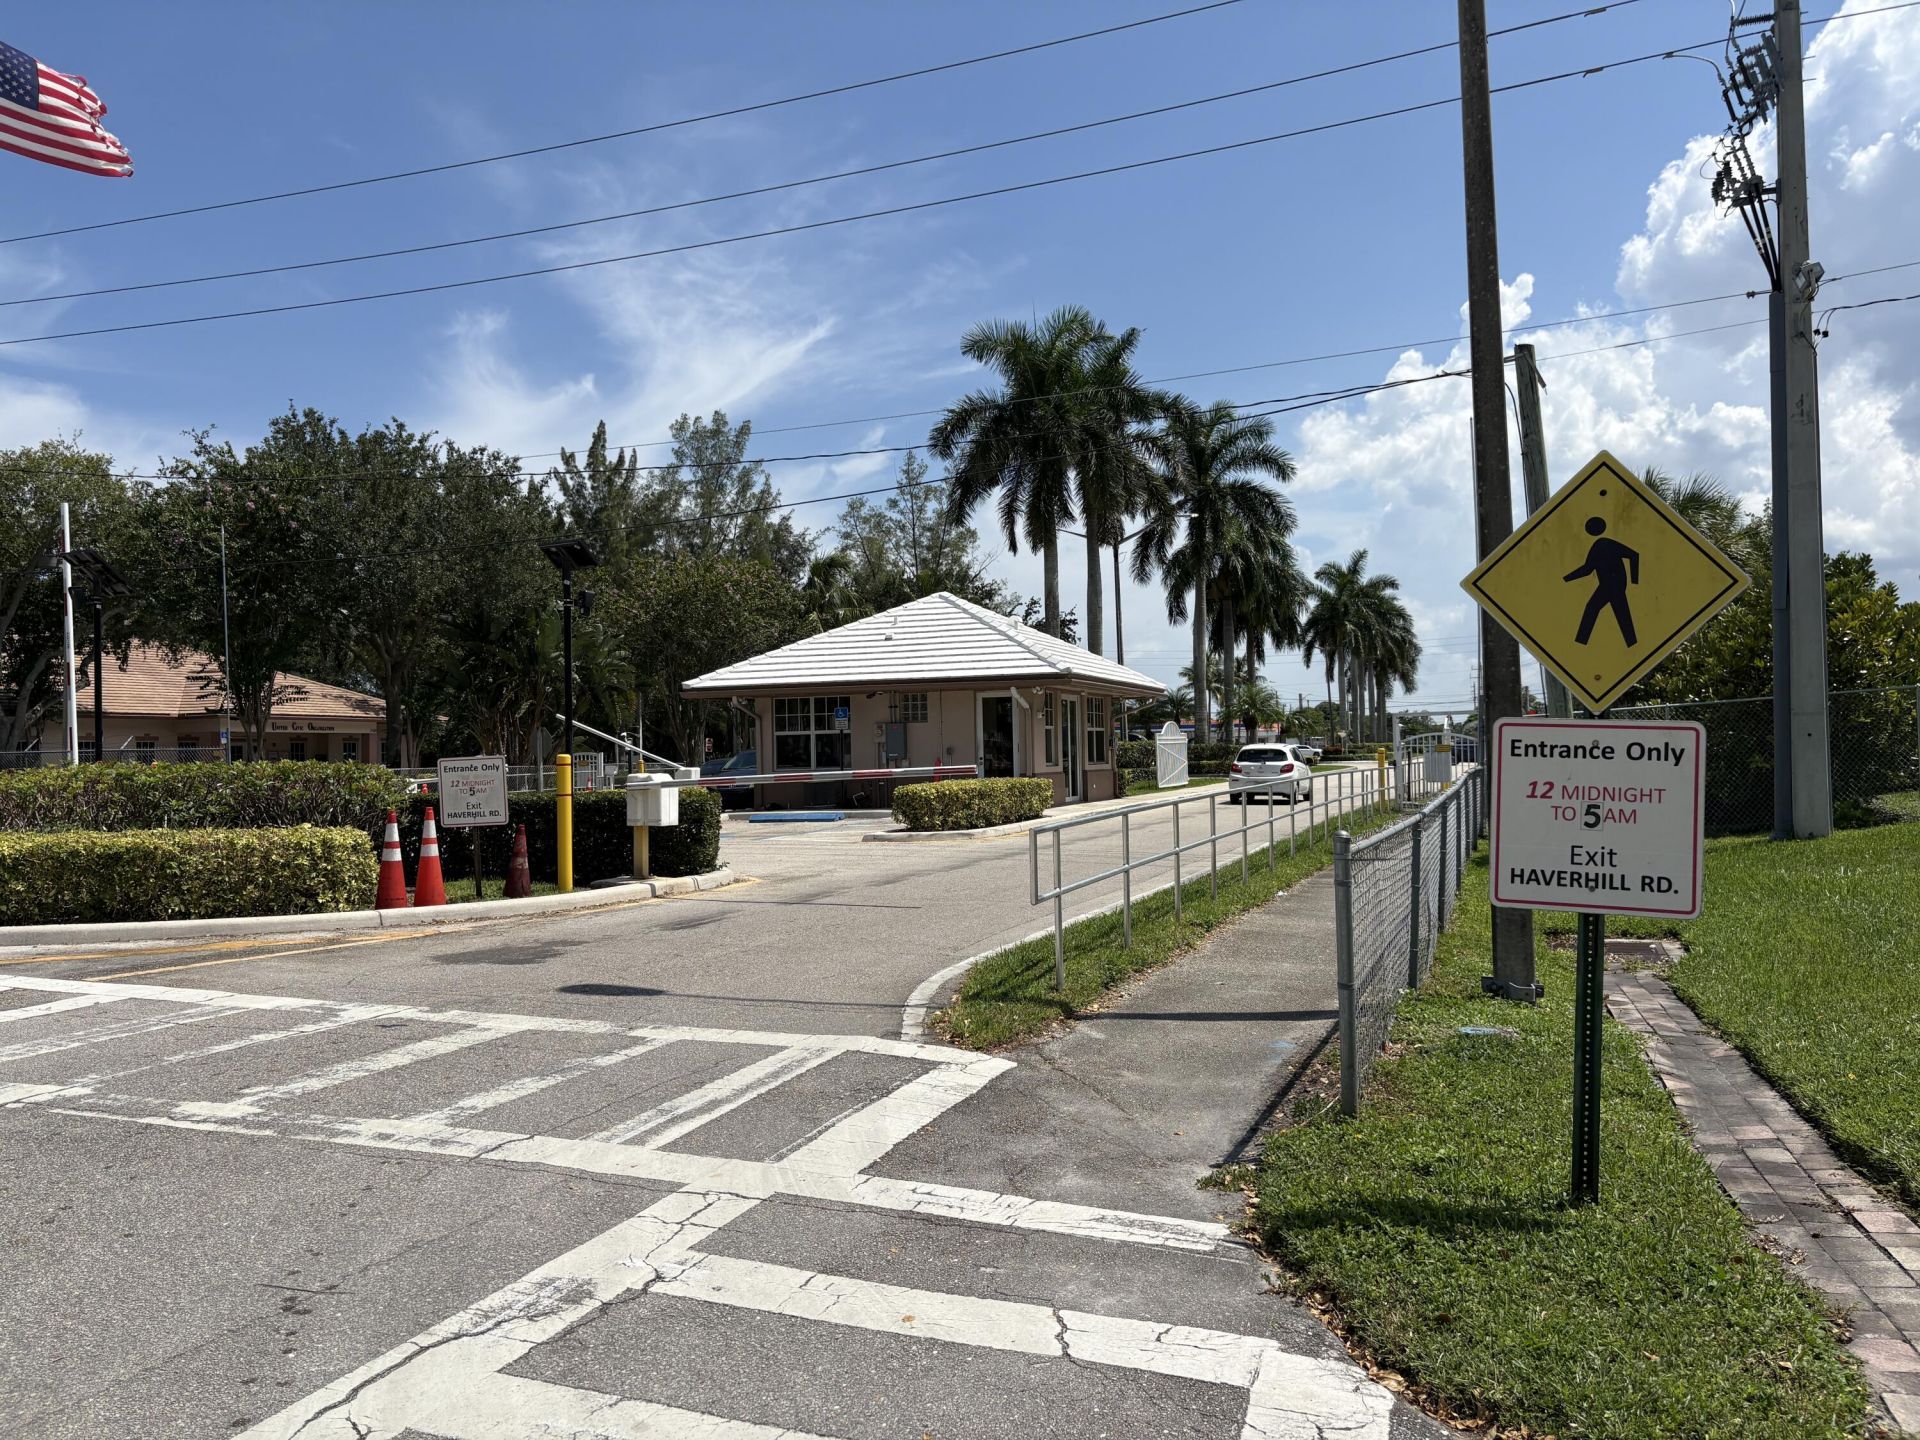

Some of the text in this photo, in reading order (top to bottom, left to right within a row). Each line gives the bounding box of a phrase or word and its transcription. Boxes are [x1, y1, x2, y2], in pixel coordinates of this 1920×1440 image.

[1510, 738, 1685, 766] Entrance Only
[444, 763, 500, 773] Entrance Only
[1526, 780, 1666, 804] 12 MIDNIGHT
[466, 802, 482, 810] Exit
[1550, 805, 1576, 821] TO
[1570, 845, 1618, 868] Exit
[1510, 867, 1679, 894] HAVERHILL RD.
